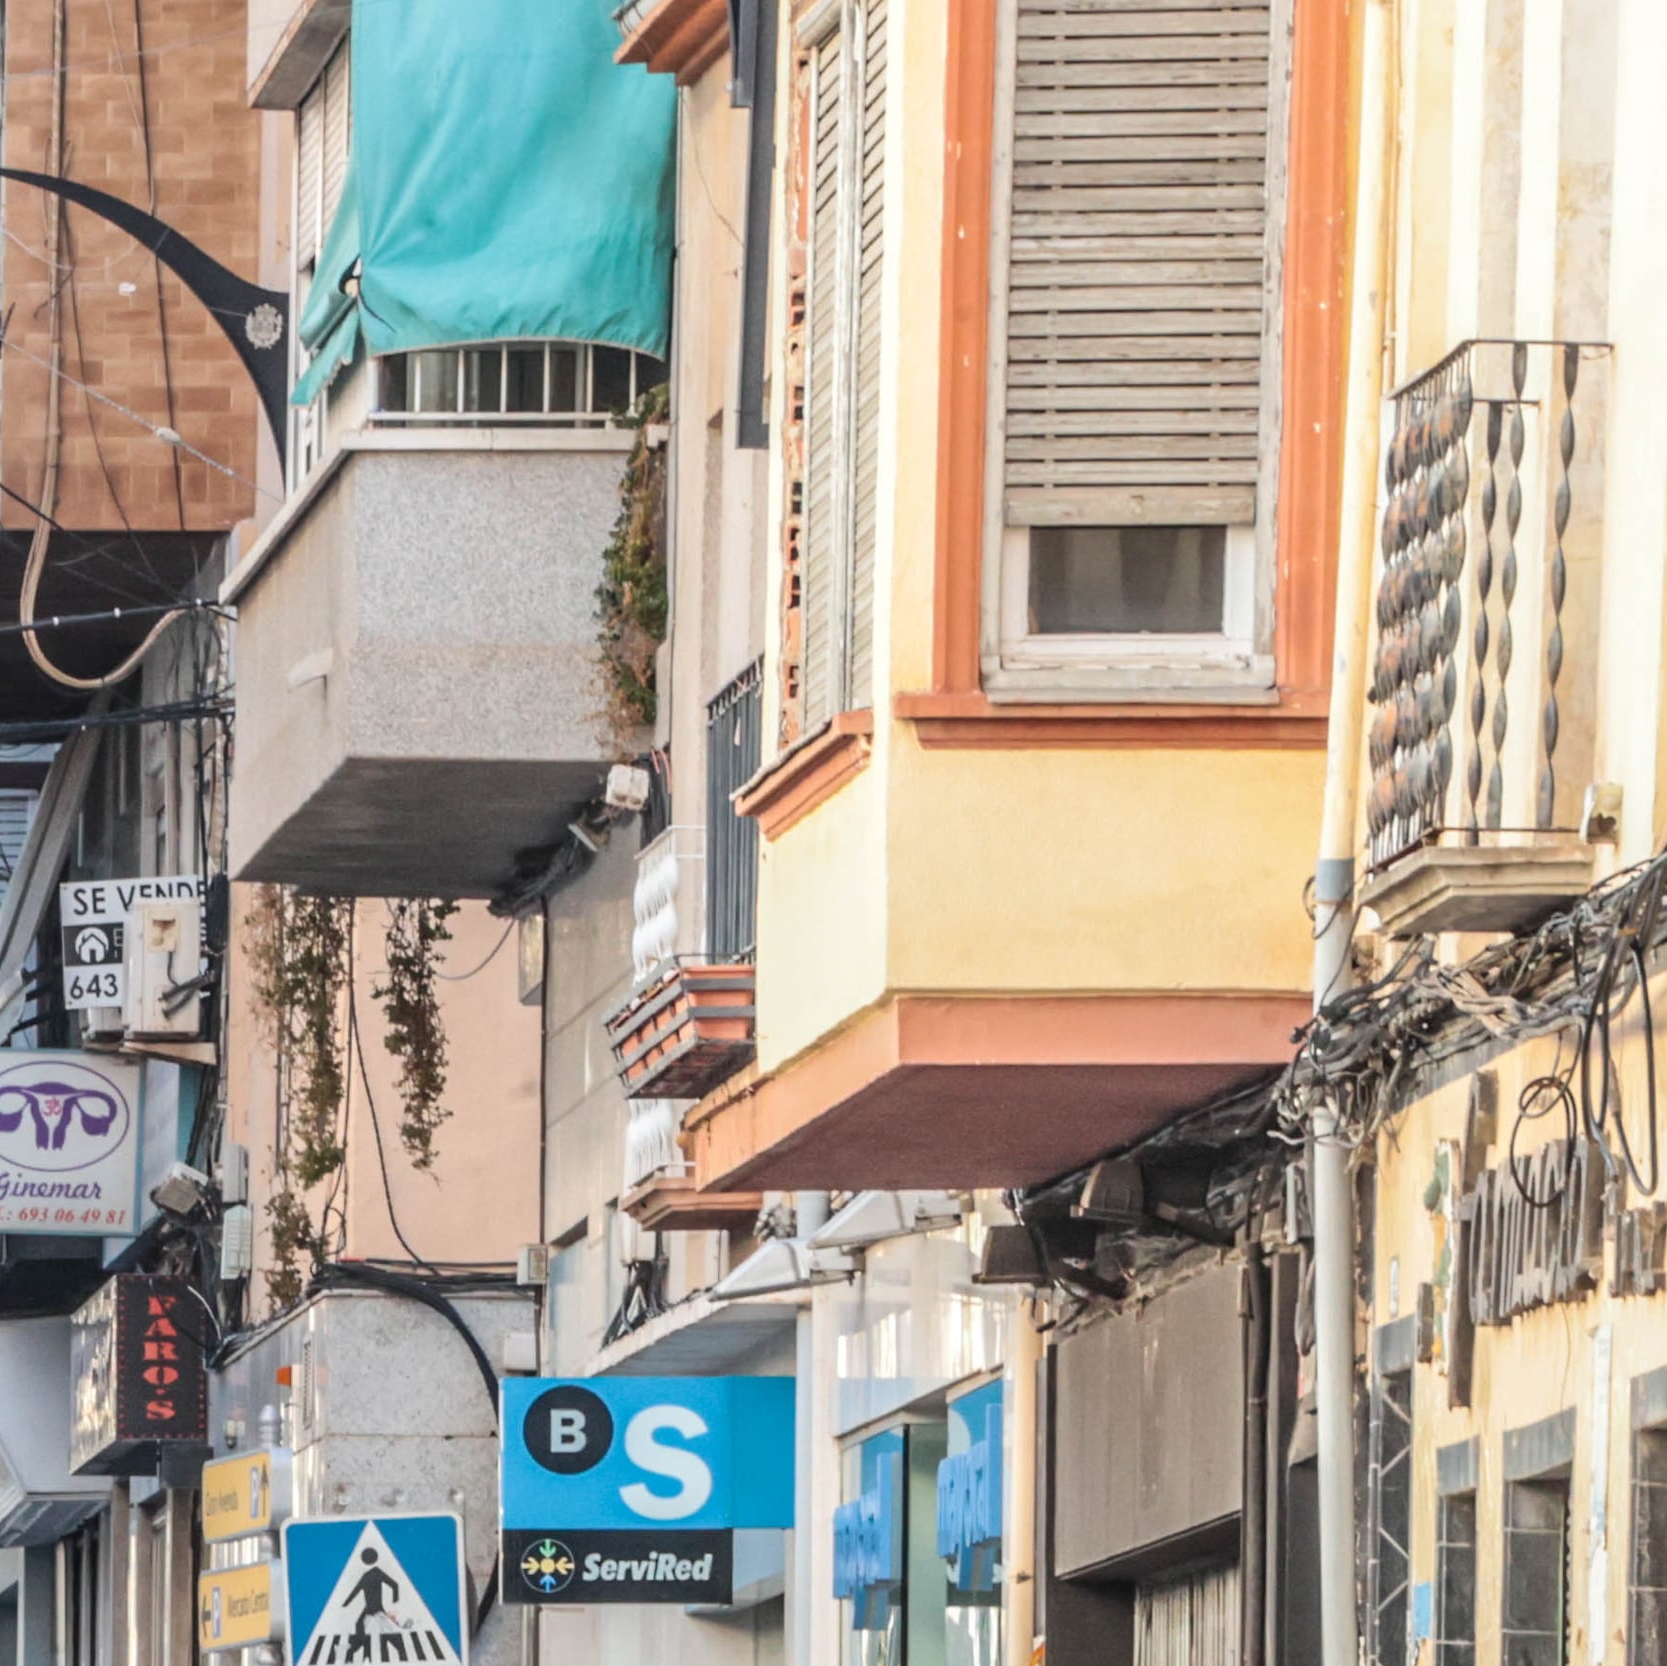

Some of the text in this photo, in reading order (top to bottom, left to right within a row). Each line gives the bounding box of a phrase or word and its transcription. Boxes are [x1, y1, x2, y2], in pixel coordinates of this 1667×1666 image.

[73, 887, 107, 916] SE
[69, 973, 119, 1000] 643
[18, 1206, 50, 1223] 693
[54, 1208, 75, 1223] 06
[80, 1208, 101, 1224] 49
[105, 1209, 128, 1225] 81
[549, 1404, 713, 1521] B S
[581, 1551, 714, 1582] ServiRed
